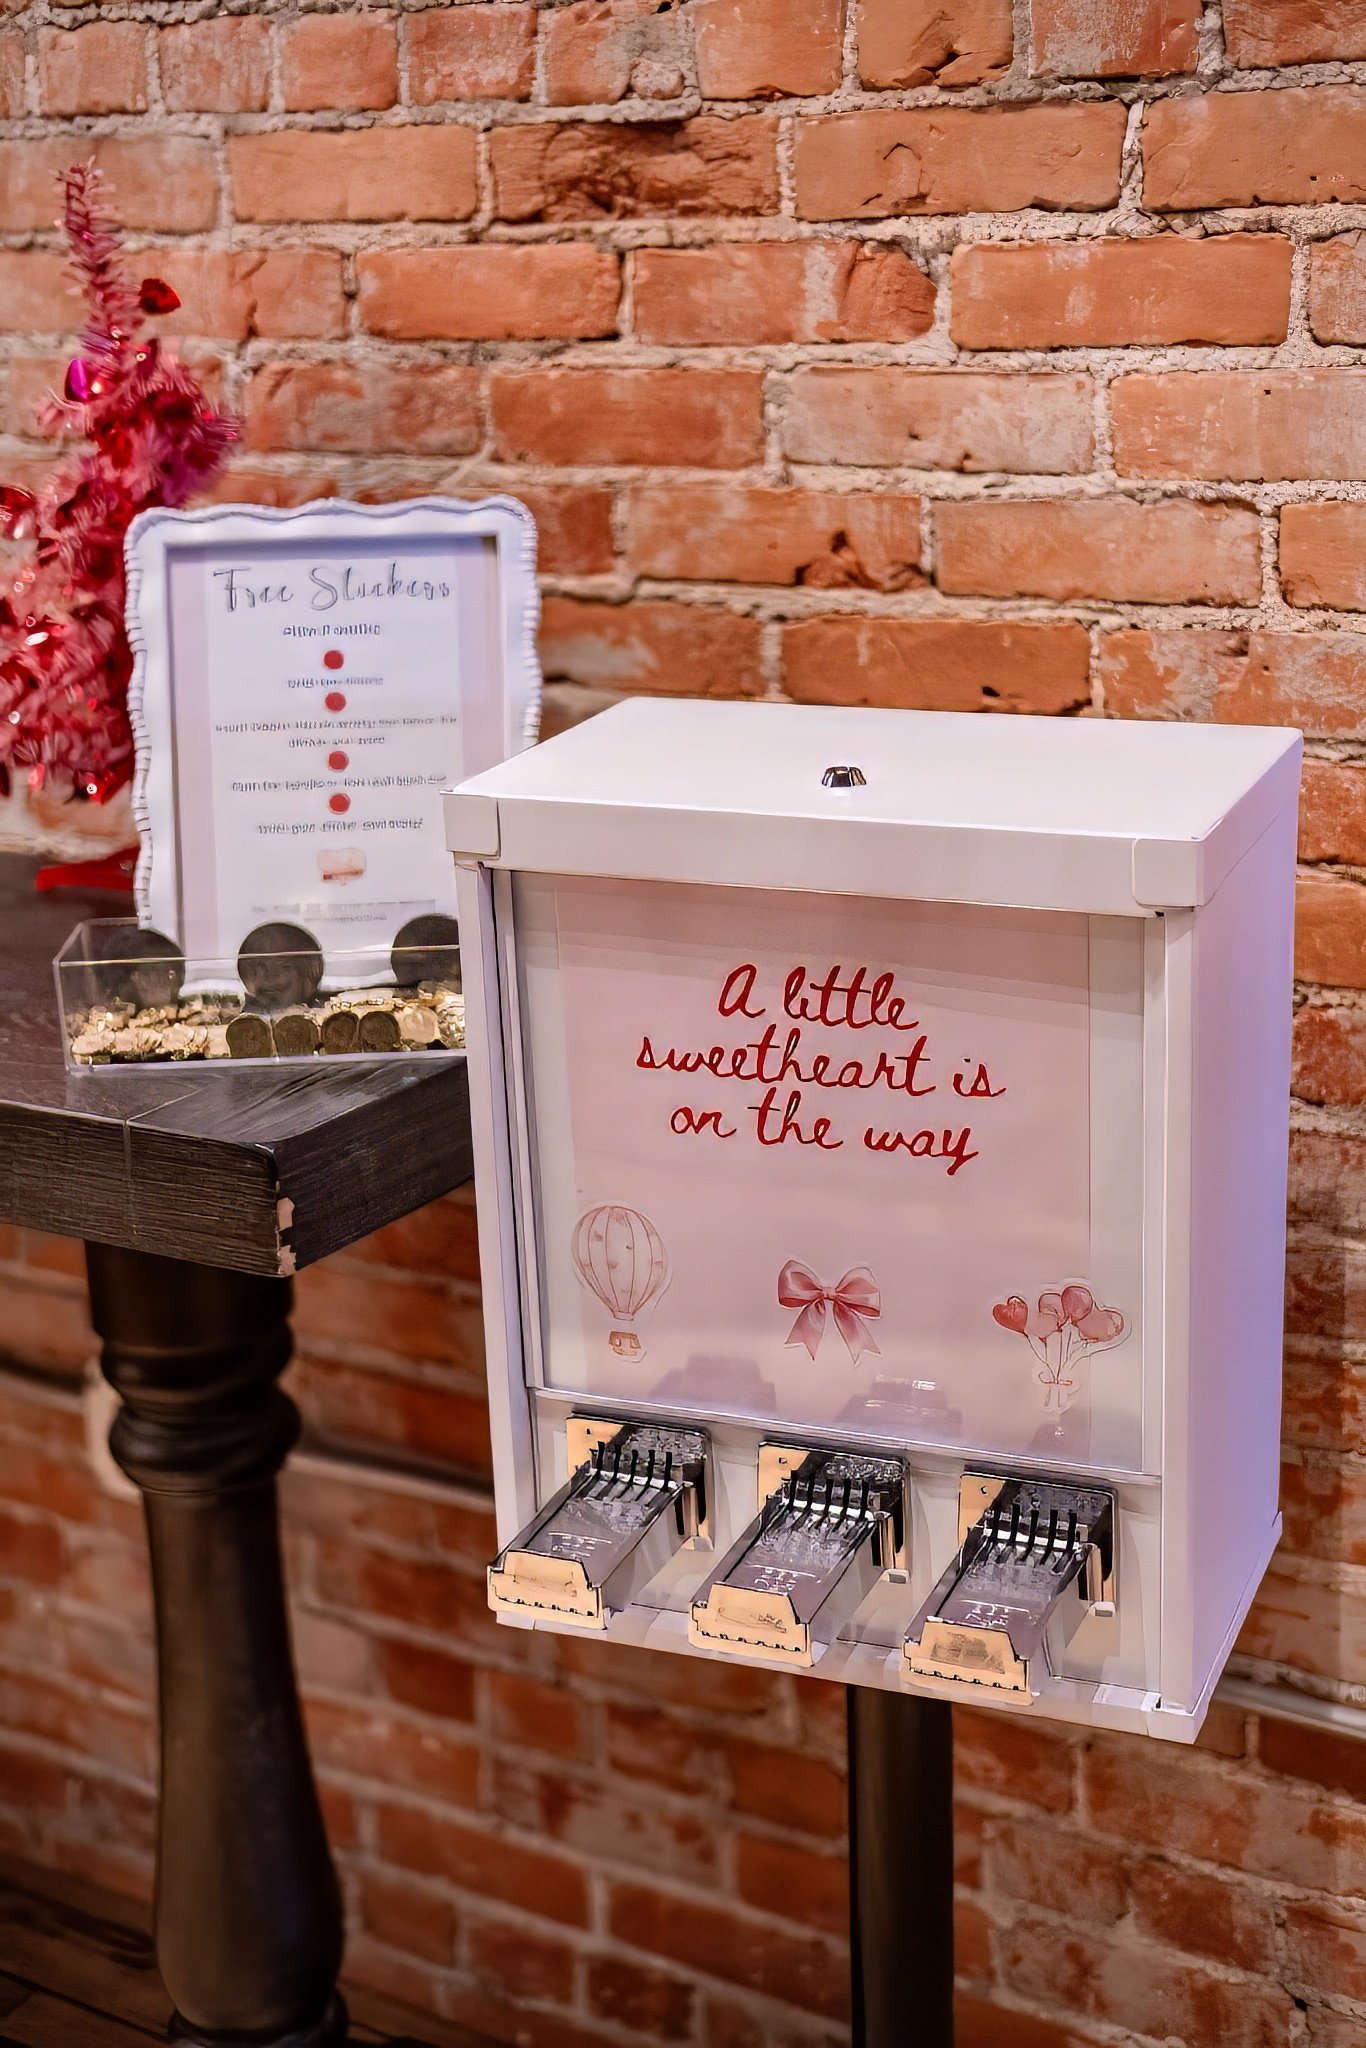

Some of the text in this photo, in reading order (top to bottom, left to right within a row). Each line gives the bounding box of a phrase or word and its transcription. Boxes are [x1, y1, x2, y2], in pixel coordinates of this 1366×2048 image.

[212, 567, 295, 613] Free
[717, 963, 920, 1031] A little
[636, 1023, 1007, 1098] sweetheart is
[670, 1086, 980, 1177] on the way
